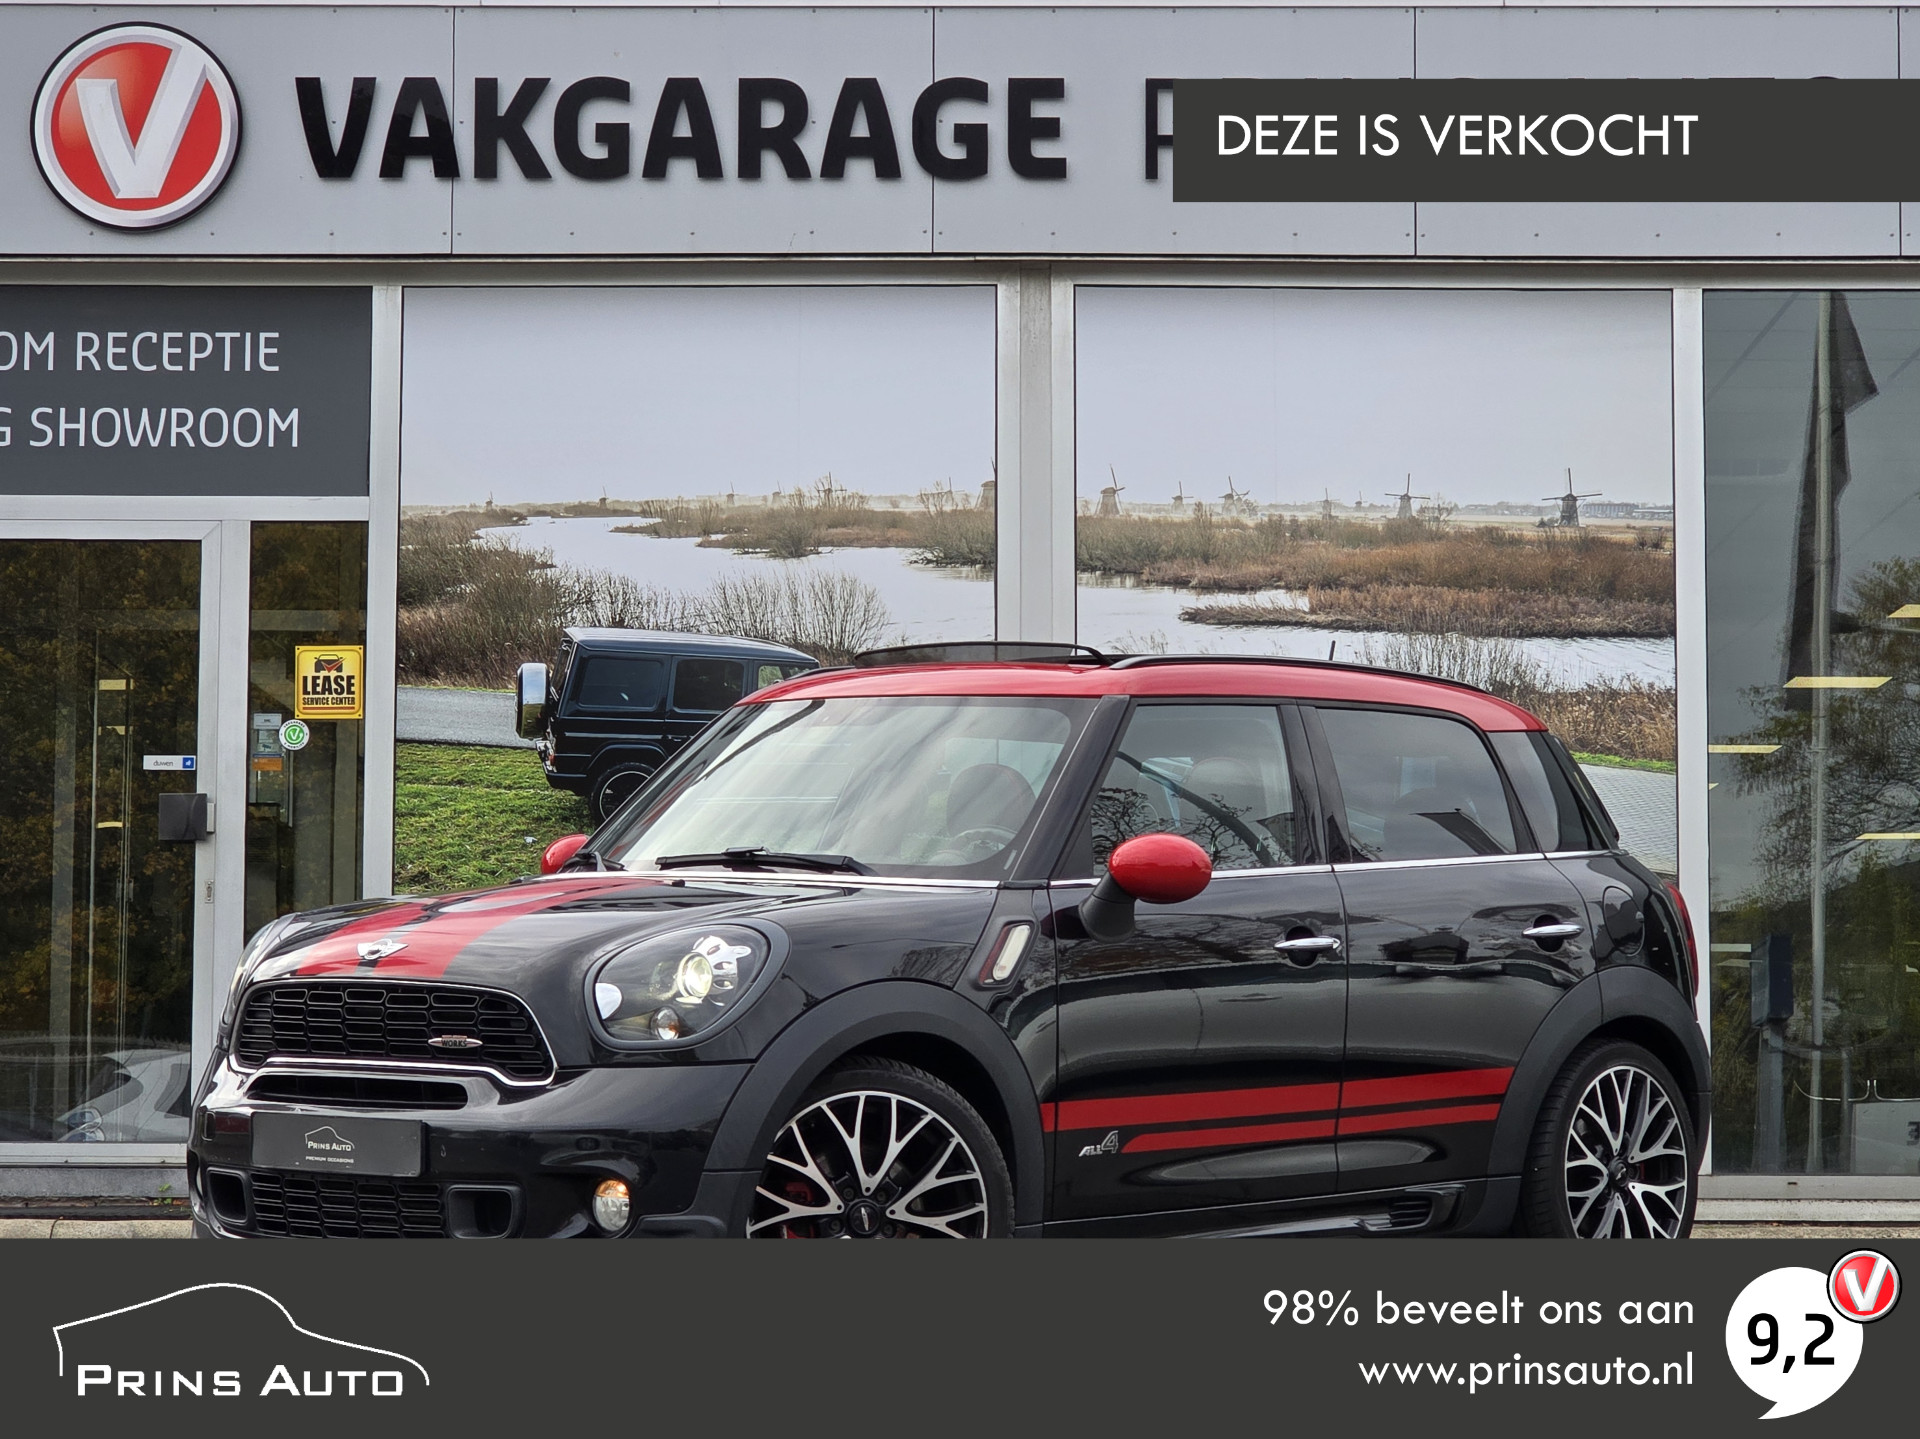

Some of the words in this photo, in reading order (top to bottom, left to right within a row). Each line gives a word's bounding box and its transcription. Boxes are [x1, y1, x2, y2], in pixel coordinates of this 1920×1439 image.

[295, 77, 1067, 181] VAKGARAGE
[76, 331, 280, 371] RECEPTIE
[29, 406, 299, 447] SHOWROOM
[302, 675, 356, 696] LEASE
[302, 697, 330, 706] SERVICE
[331, 697, 355, 706] CENTER
[442, 1039, 467, 1048] WORKS
[307, 1141, 331, 1150] PRINS
[331, 1142, 352, 1152] AUTO
